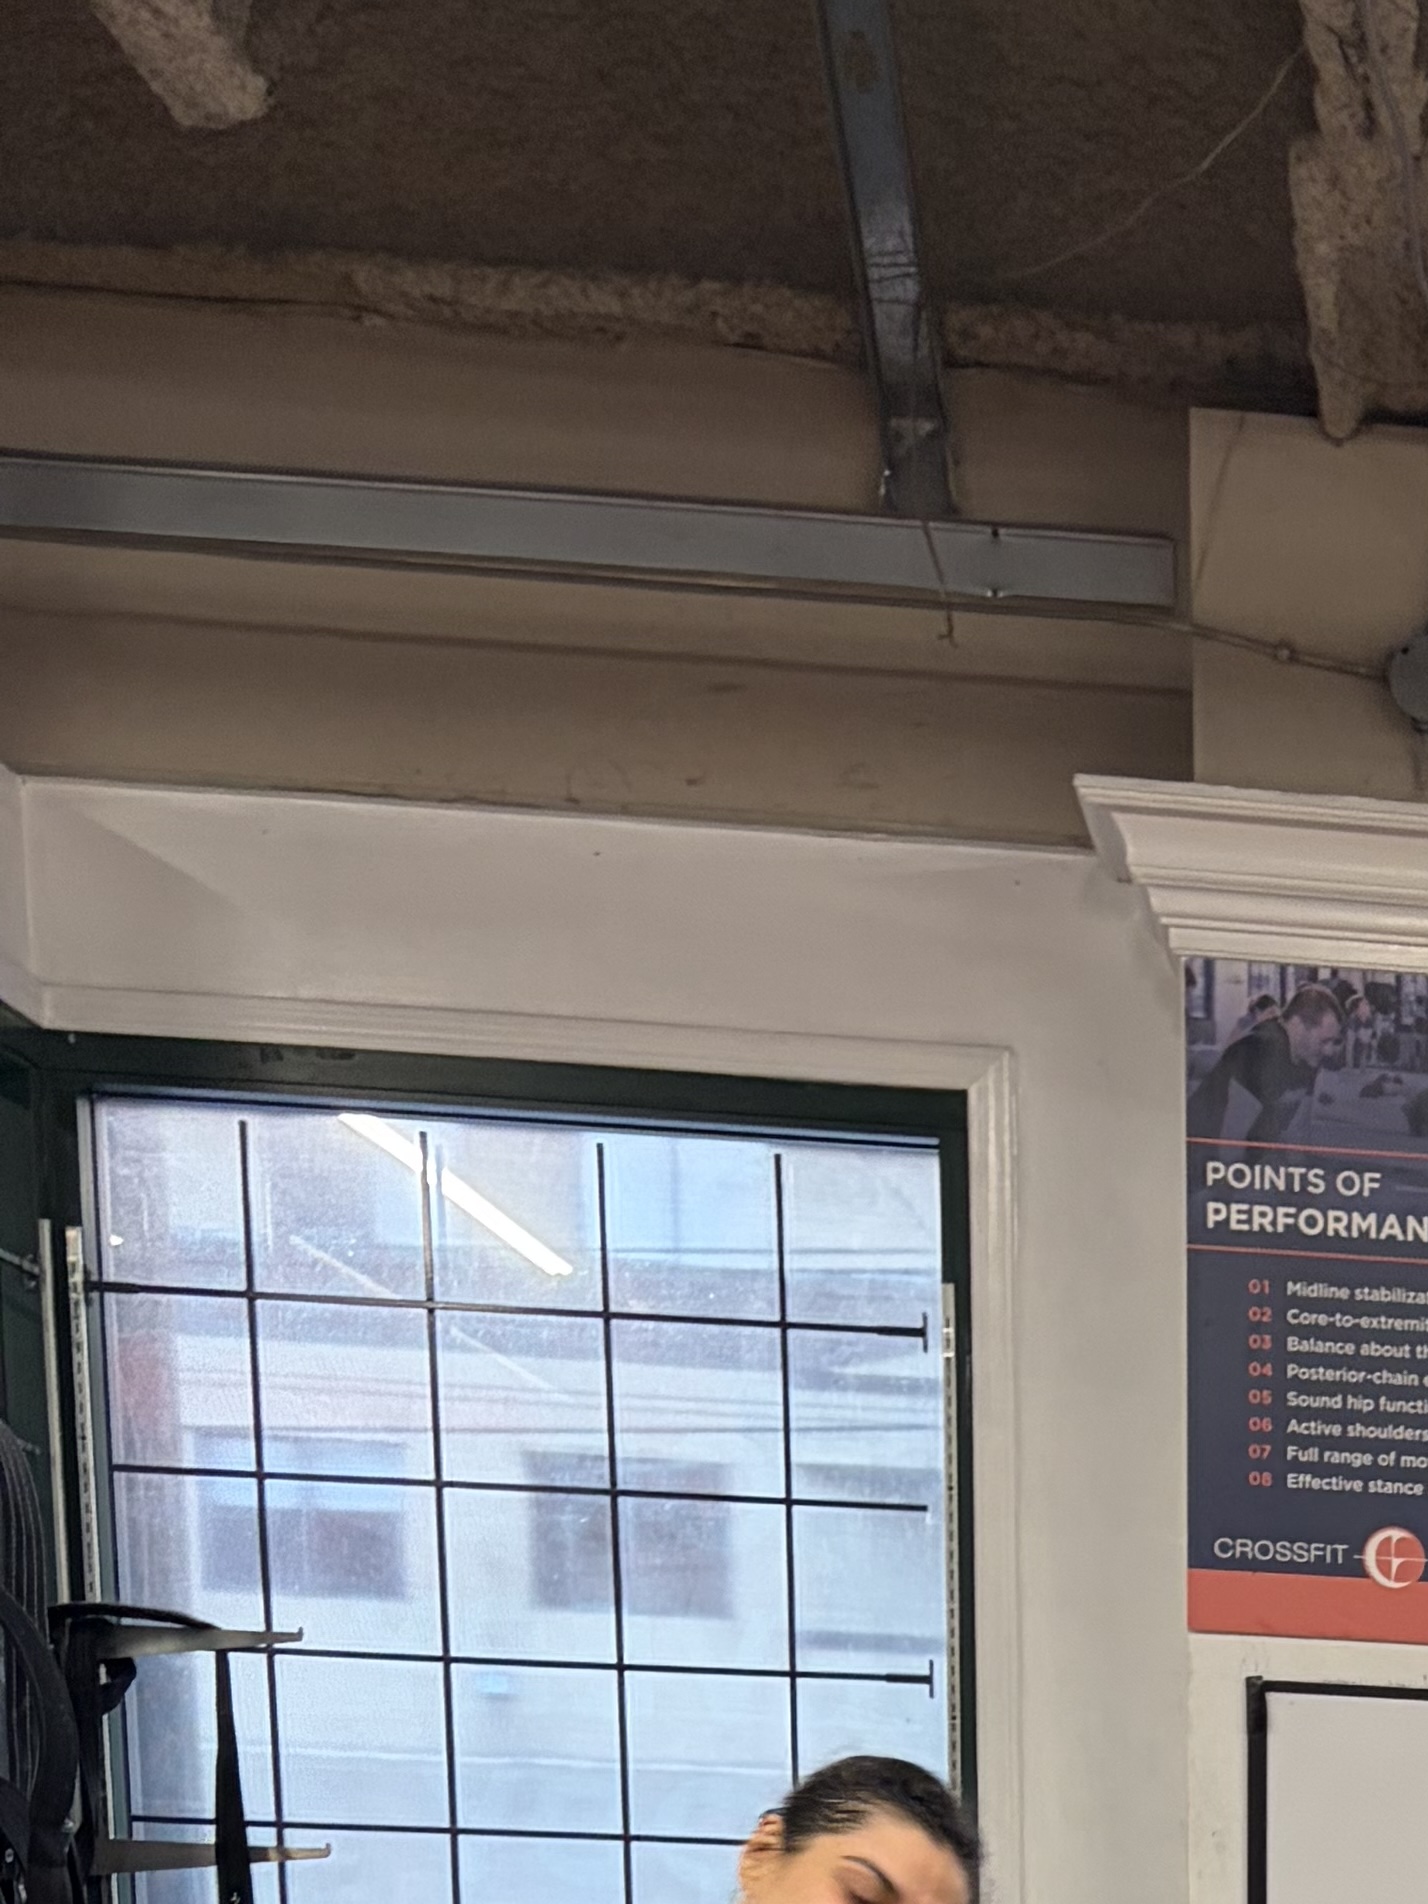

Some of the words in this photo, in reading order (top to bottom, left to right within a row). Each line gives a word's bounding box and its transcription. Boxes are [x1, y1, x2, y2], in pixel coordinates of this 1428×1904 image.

[1205, 1160, 1326, 1194] POINTS
[1336, 1170, 1382, 1197] OF
[1248, 1279, 1270, 1295] 01
[1286, 1280, 1351, 1301] Midline
[1248, 1306, 1272, 1323] 02
[1248, 1334, 1272, 1350] 03
[1286, 1335, 1356, 1356] Balance
[1359, 1340, 1411, 1359] about
[1248, 1361, 1273, 1378] 04
[1286, 1362, 1420, 1388] Posterior-chain
[1248, 1389, 1272, 1405] 05
[1286, 1390, 1343, 1410] Sound
[1346, 1394, 1375, 1413] hip
[1248, 1416, 1273, 1433] 06
[1286, 1418, 1342, 1437] Active
[1248, 1444, 1272, 1460] 07
[1286, 1445, 1319, 1462] Full
[1323, 1451, 1374, 1468] range
[1377, 1451, 1396, 1467] of
[1248, 1471, 1273, 1487] 08
[1286, 1472, 1364, 1493] Effective
[1367, 1479, 1424, 1496] stance
[1212, 1537, 1349, 1564] CROSSFIT
